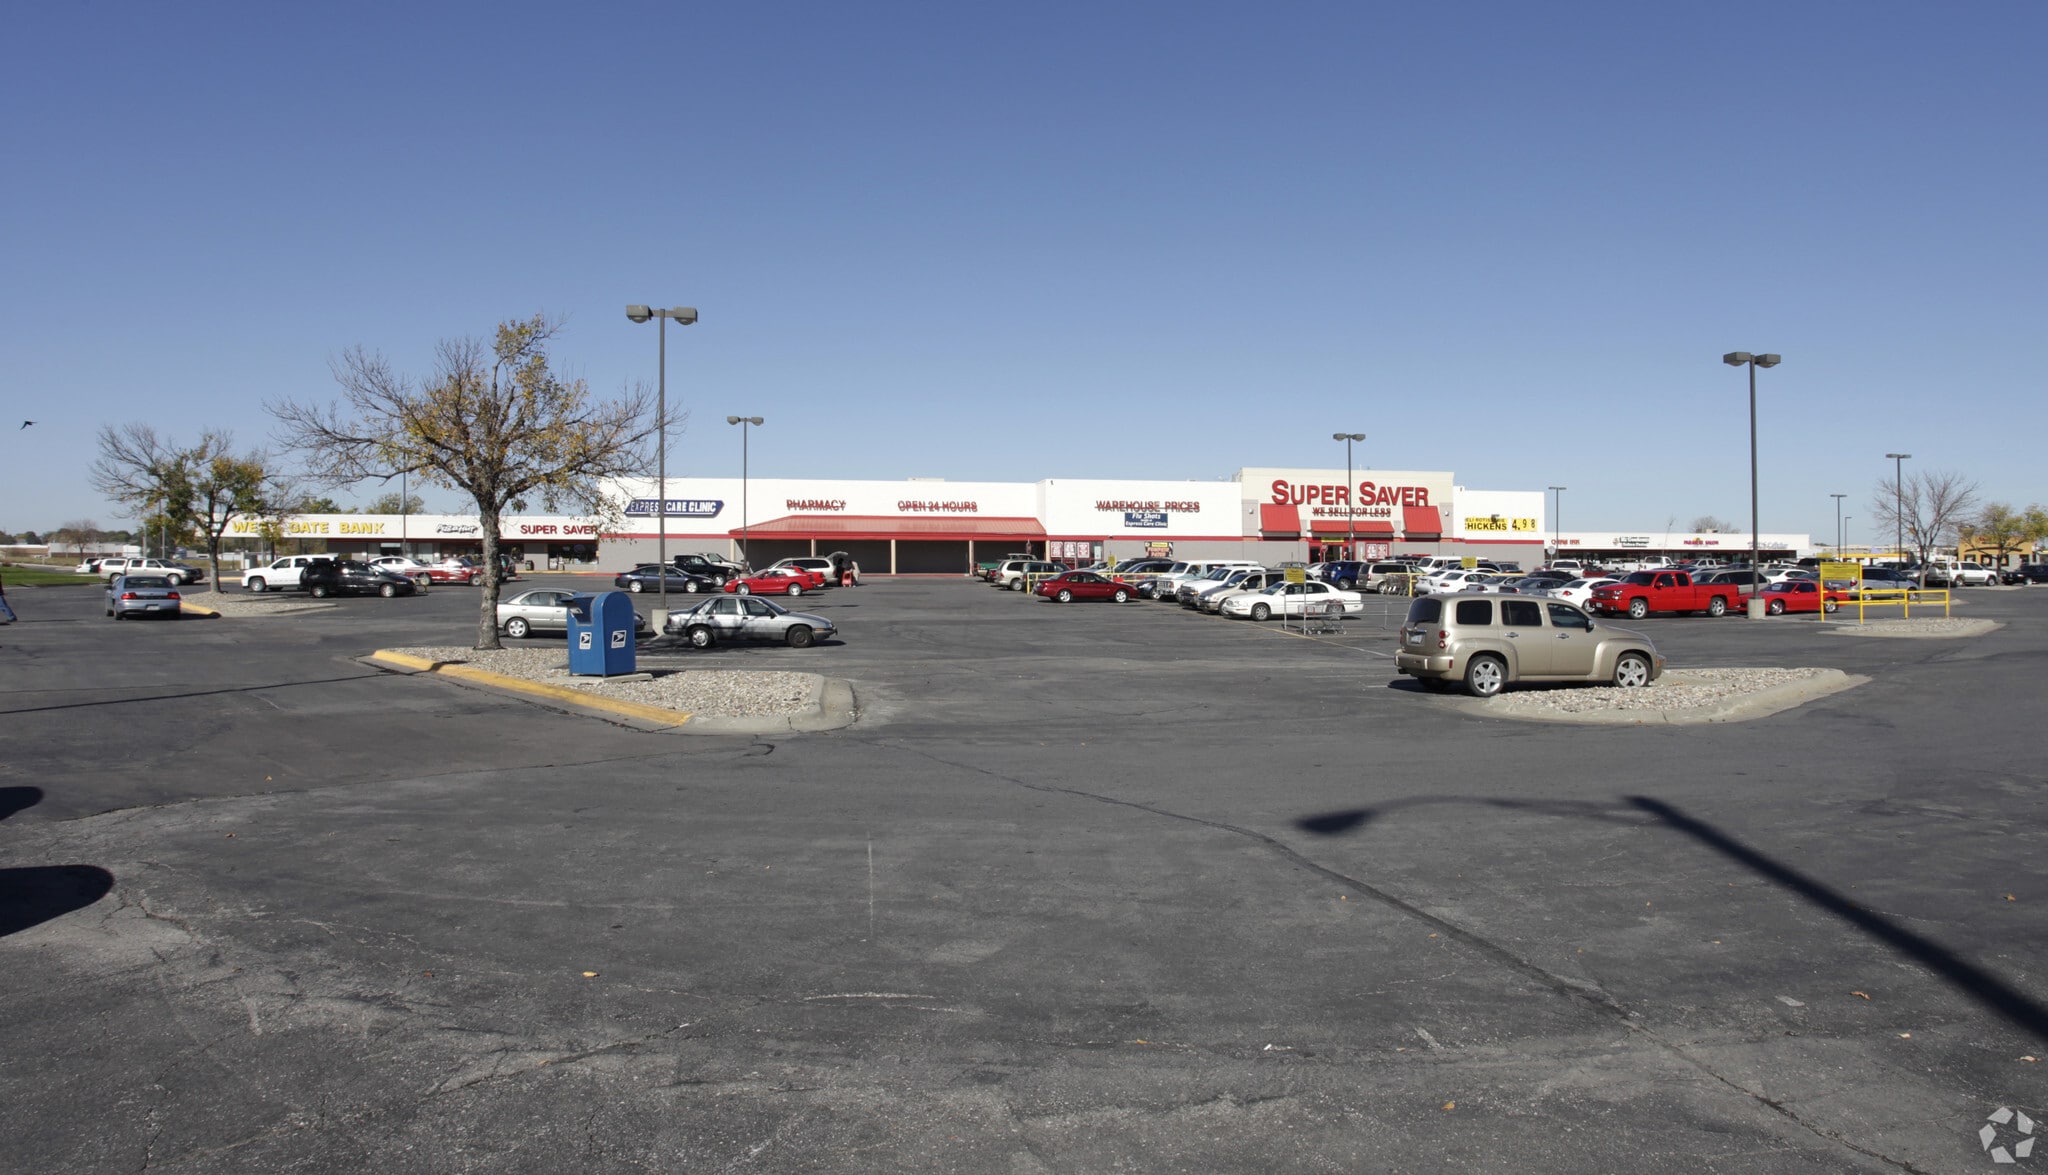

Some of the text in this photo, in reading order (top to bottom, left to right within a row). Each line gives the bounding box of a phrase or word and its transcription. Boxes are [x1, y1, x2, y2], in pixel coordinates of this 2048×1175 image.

[1271, 480, 1429, 507] SUPER SAVER
[630, 501, 716, 512] EXPRES CARE CLINIC
[786, 499, 846, 511] PHARMACY
[897, 500, 977, 512] OPEN 24 HOURS
[1095, 500, 1200, 513] WAREHOUSE PRICES
[1312, 506, 1326, 517] WE
[1328, 507, 1348, 517] SELL
[1369, 507, 1391, 517] LESS
[290, 522, 329, 533] GATE
[339, 522, 384, 534] BANK
[520, 525, 598, 535] SUPER SAVER
